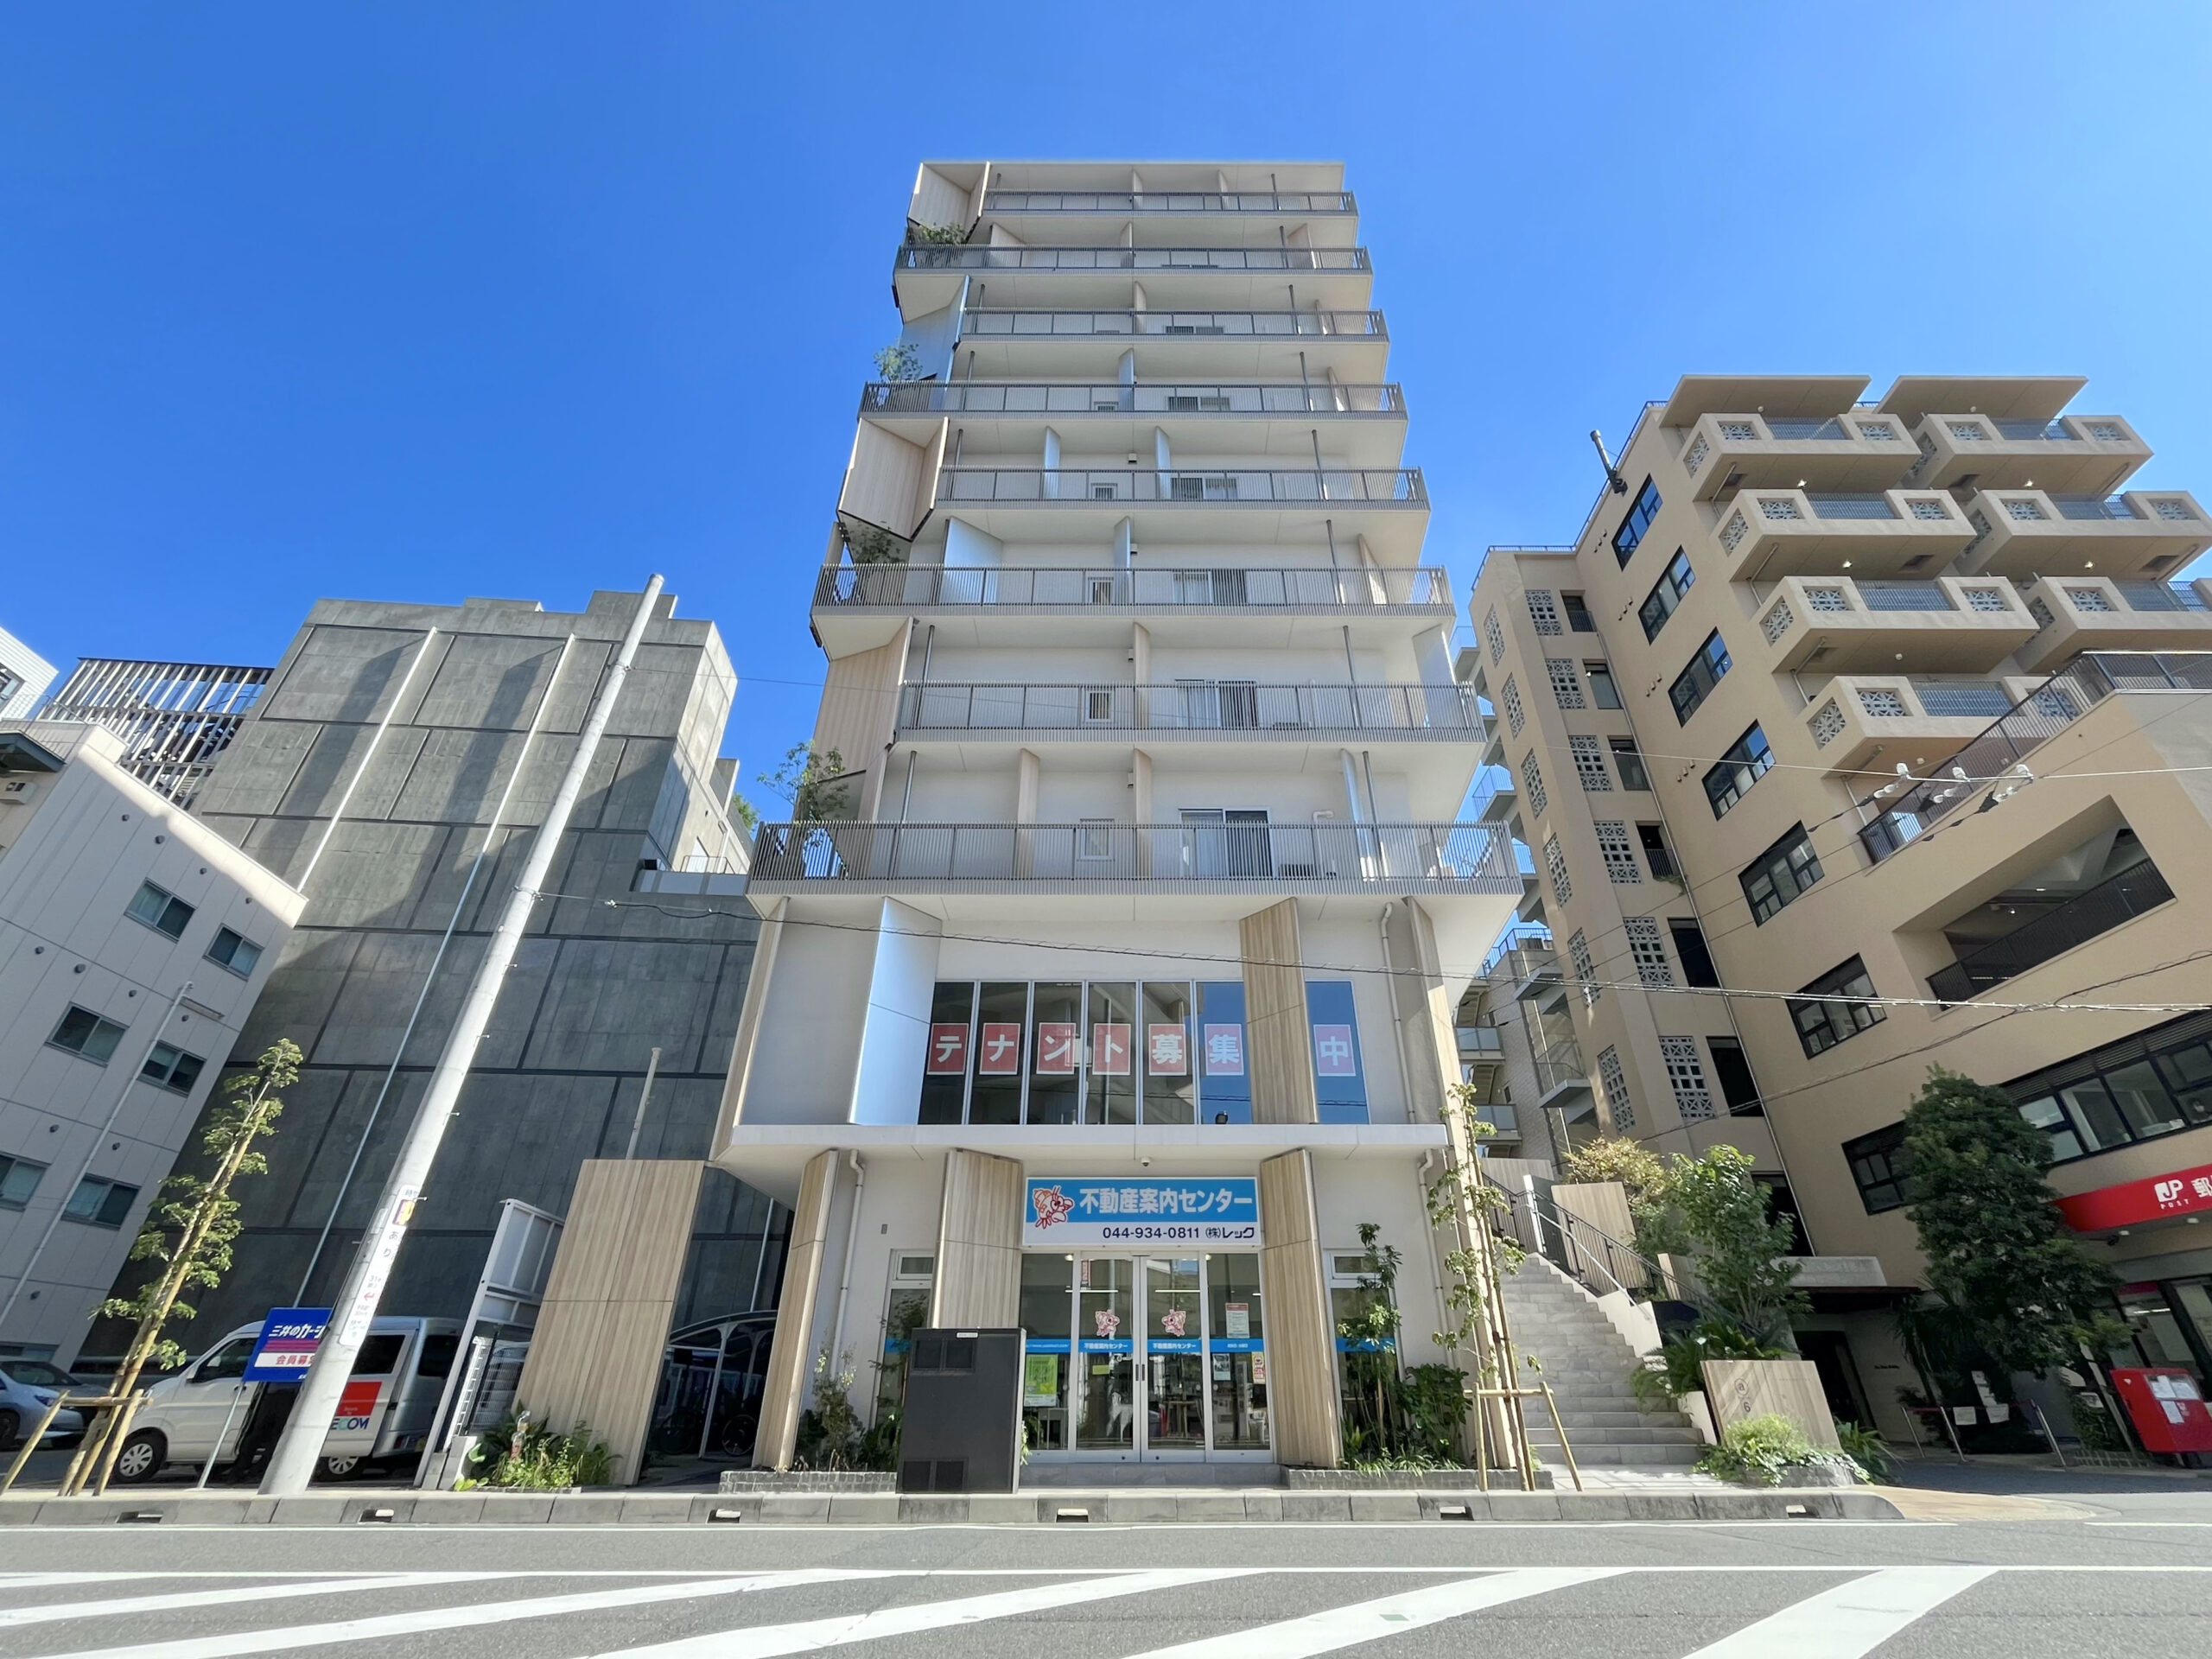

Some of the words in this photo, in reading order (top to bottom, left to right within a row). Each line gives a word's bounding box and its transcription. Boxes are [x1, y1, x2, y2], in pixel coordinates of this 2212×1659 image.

[935, 1033, 1351, 1067] テナント募集中
[2154, 1179, 2183, 1203] JP
[2191, 1175, 2212, 1198] 郵
[1079, 1187, 1253, 1214] 不動産案内センター
[2160, 1198, 2190, 1210] POST
[1103, 1227, 1199, 1240] 044-934-0811
[1744, 1402, 1751, 1413] 6
